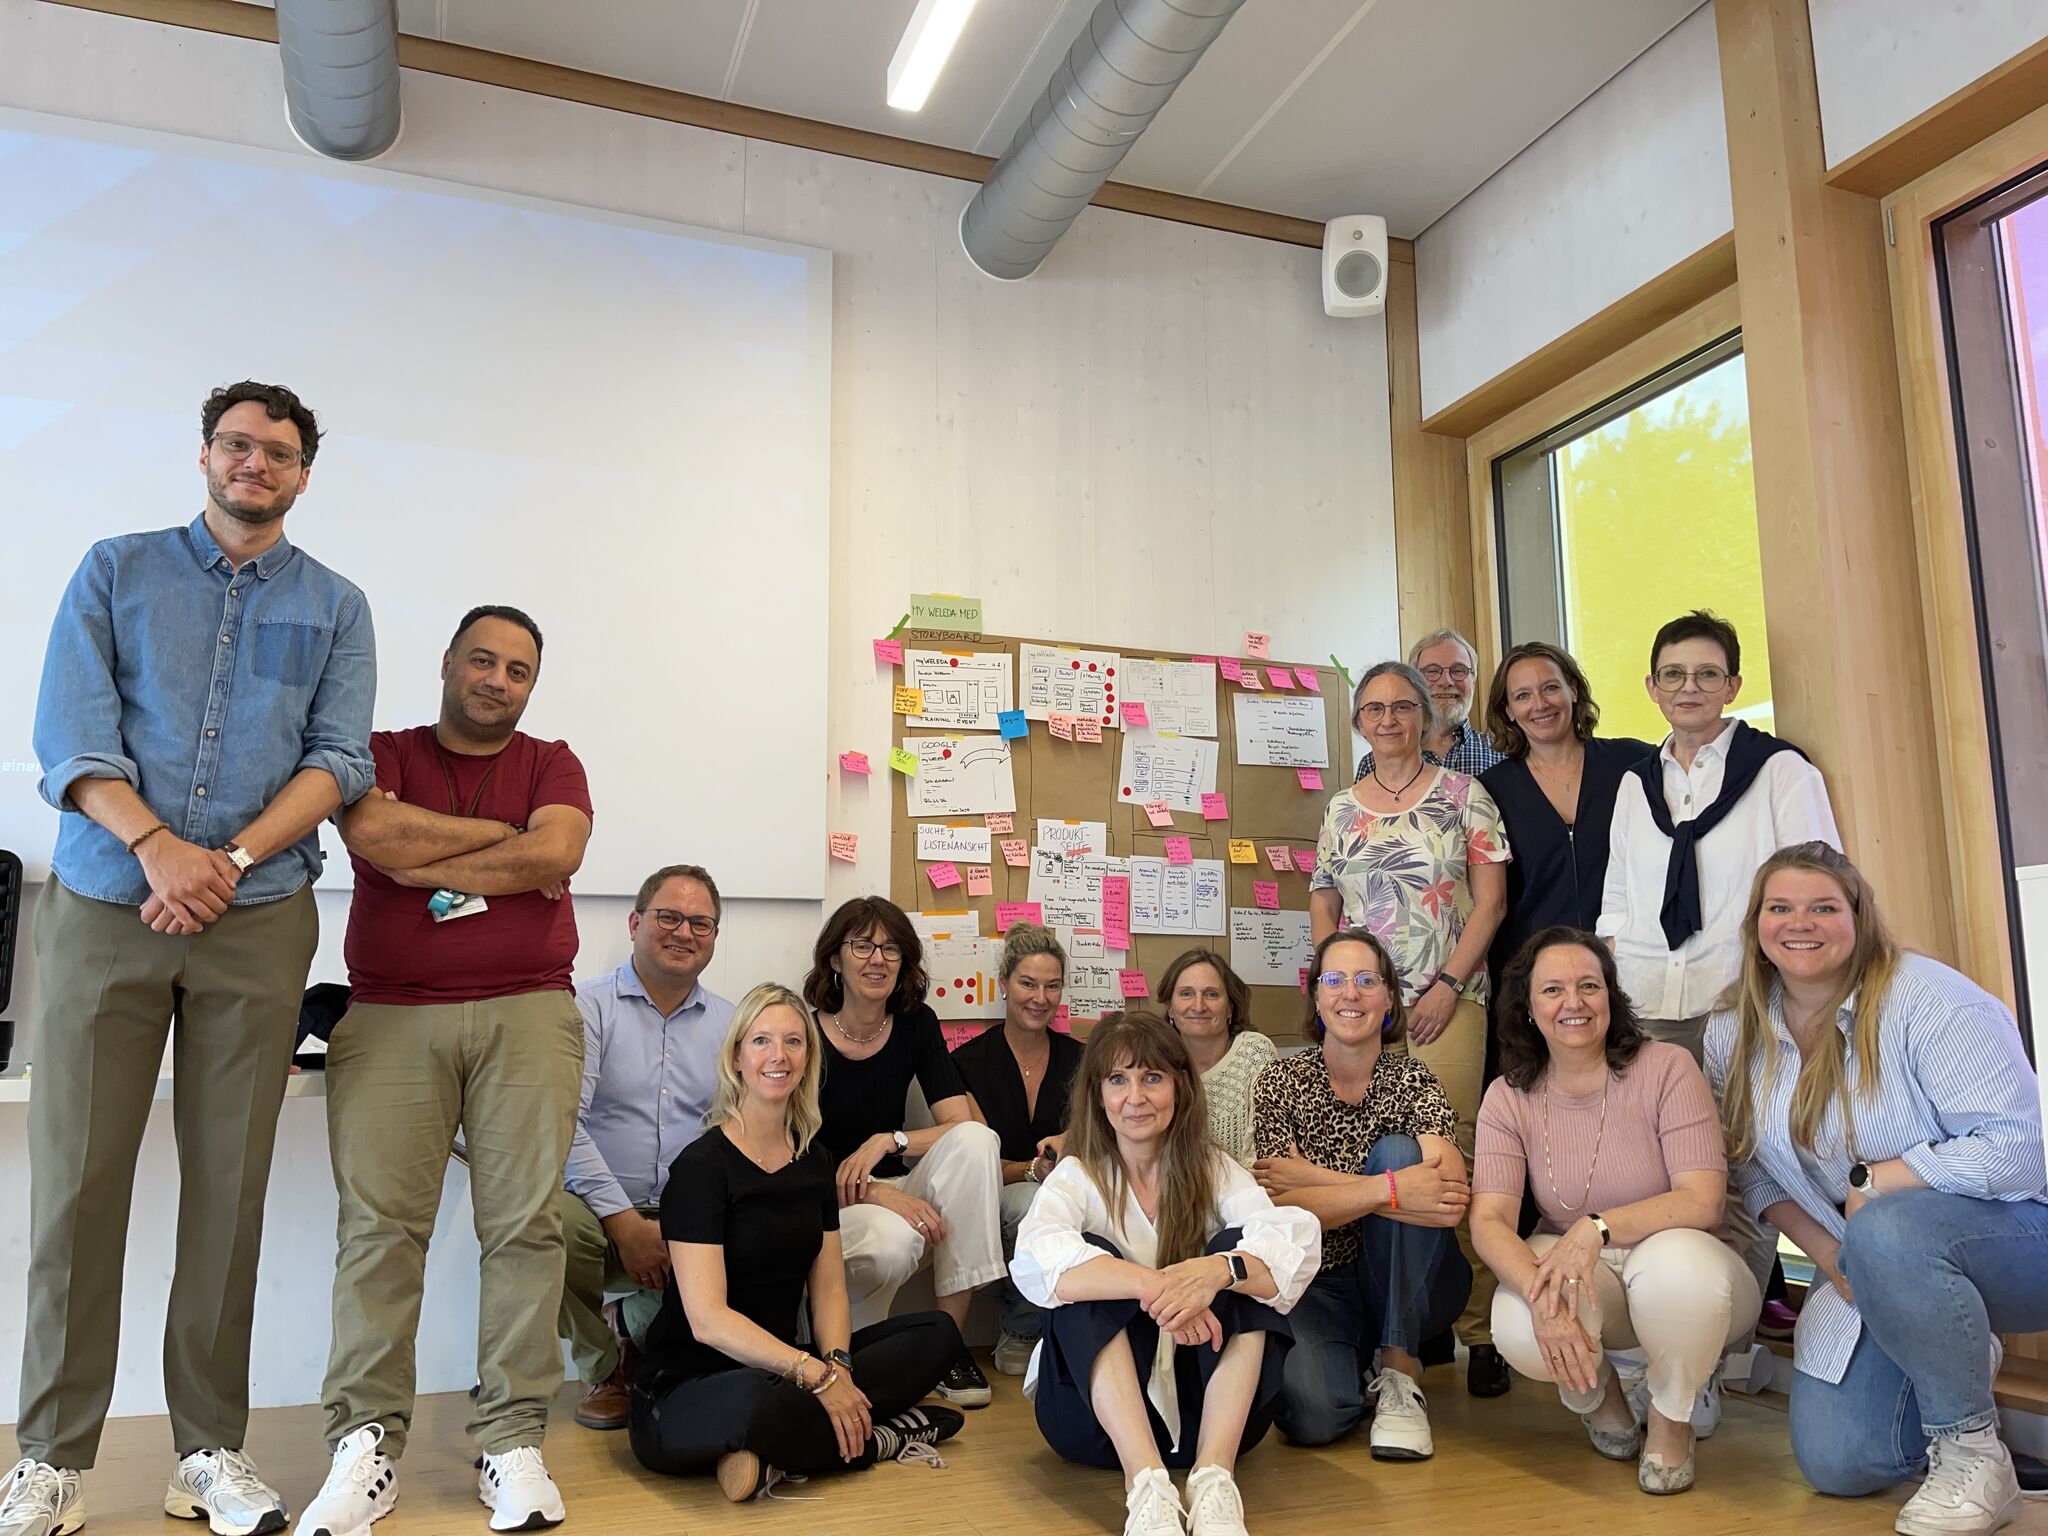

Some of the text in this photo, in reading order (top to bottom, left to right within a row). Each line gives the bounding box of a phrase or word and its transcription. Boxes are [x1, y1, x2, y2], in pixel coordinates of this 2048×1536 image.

[911, 605, 979, 620] MY WELEDA MED
[910, 630, 982, 642] STORYBOARD
[921, 741, 959, 749] GOOGLE
[918, 825, 947, 836] SUCHE
[1042, 825, 1091, 841] PRODUKT-
[923, 840, 990, 852] LISTENANSICHT
